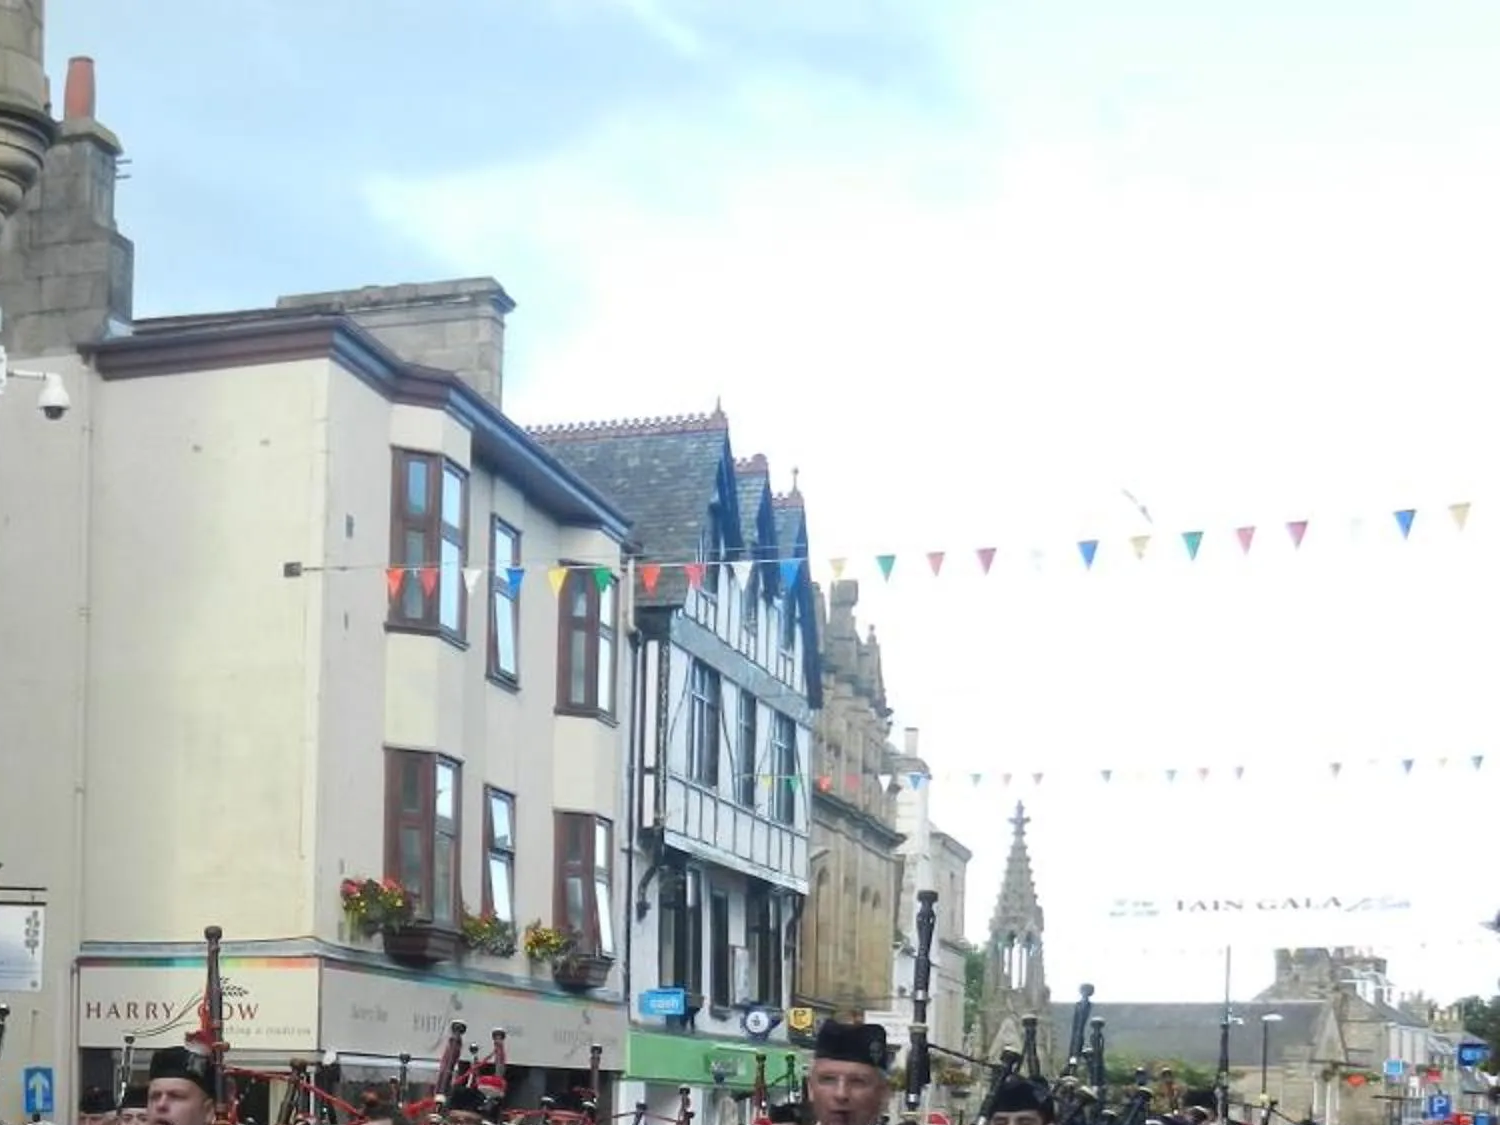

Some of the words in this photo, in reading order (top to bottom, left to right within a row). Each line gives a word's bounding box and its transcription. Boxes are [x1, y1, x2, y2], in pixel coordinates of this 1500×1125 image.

[86, 1001, 175, 1021] HARRY
[197, 1001, 260, 1022] OW
[1433, 1096, 1446, 1113] P
